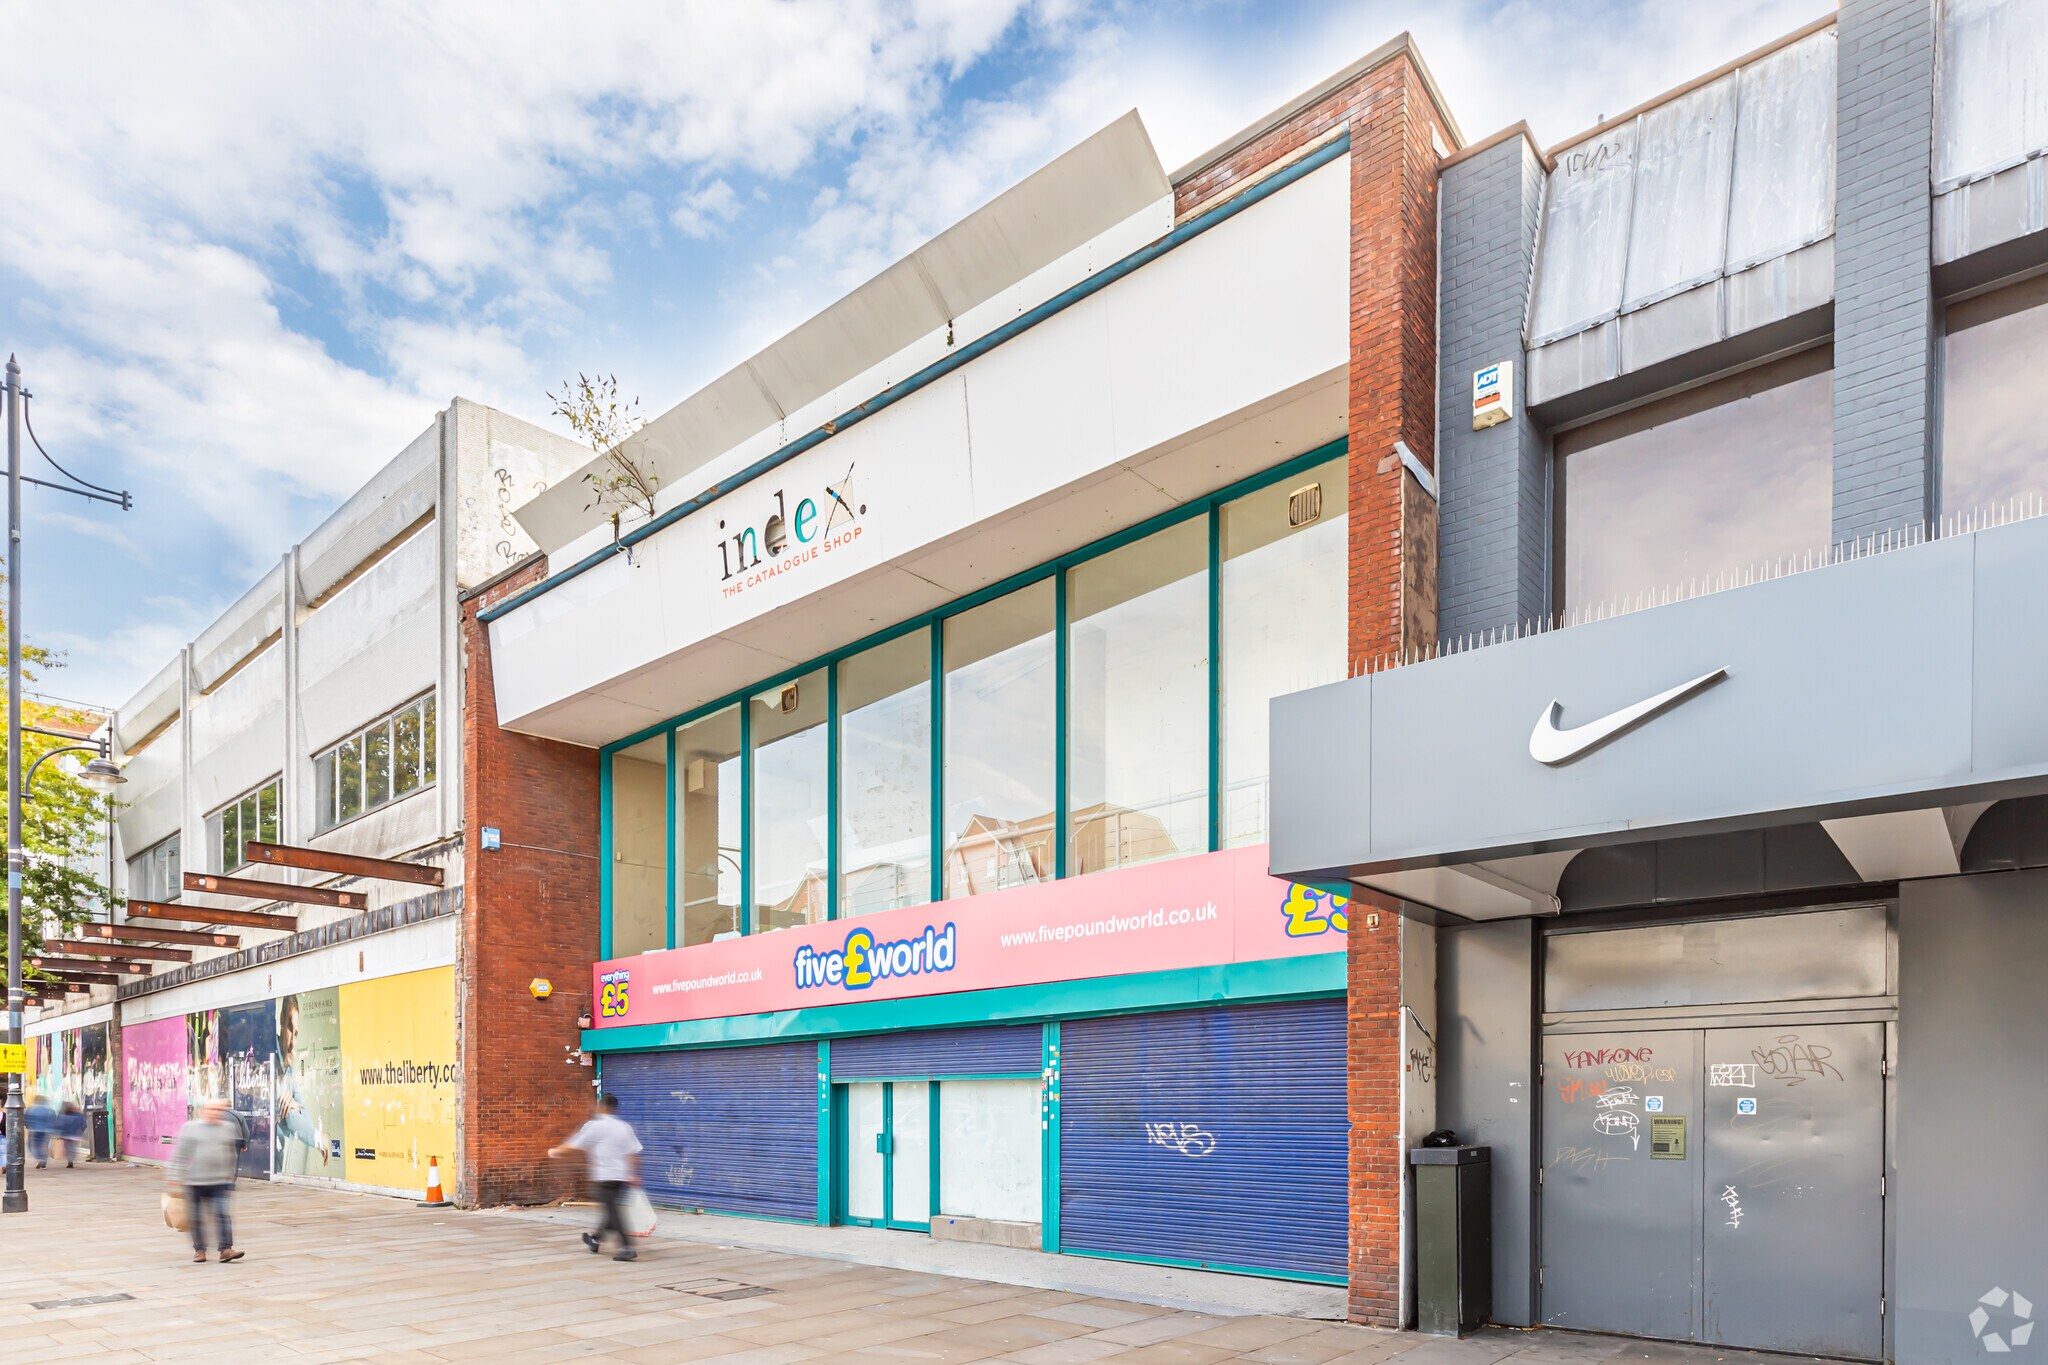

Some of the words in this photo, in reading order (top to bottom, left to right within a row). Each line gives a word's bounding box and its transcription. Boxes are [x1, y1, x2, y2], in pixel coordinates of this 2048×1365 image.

[722, 581, 743, 599] THE
[747, 546, 819, 588] CATALOGUE
[823, 527, 862, 553] SHOP
[1000, 901, 1218, 948] www.fivepoundworld.co.uk
[600, 969, 630, 983] everything
[652, 967, 763, 996] www.fivepoundworld.co.uk
[600, 982, 630, 1017] £5
